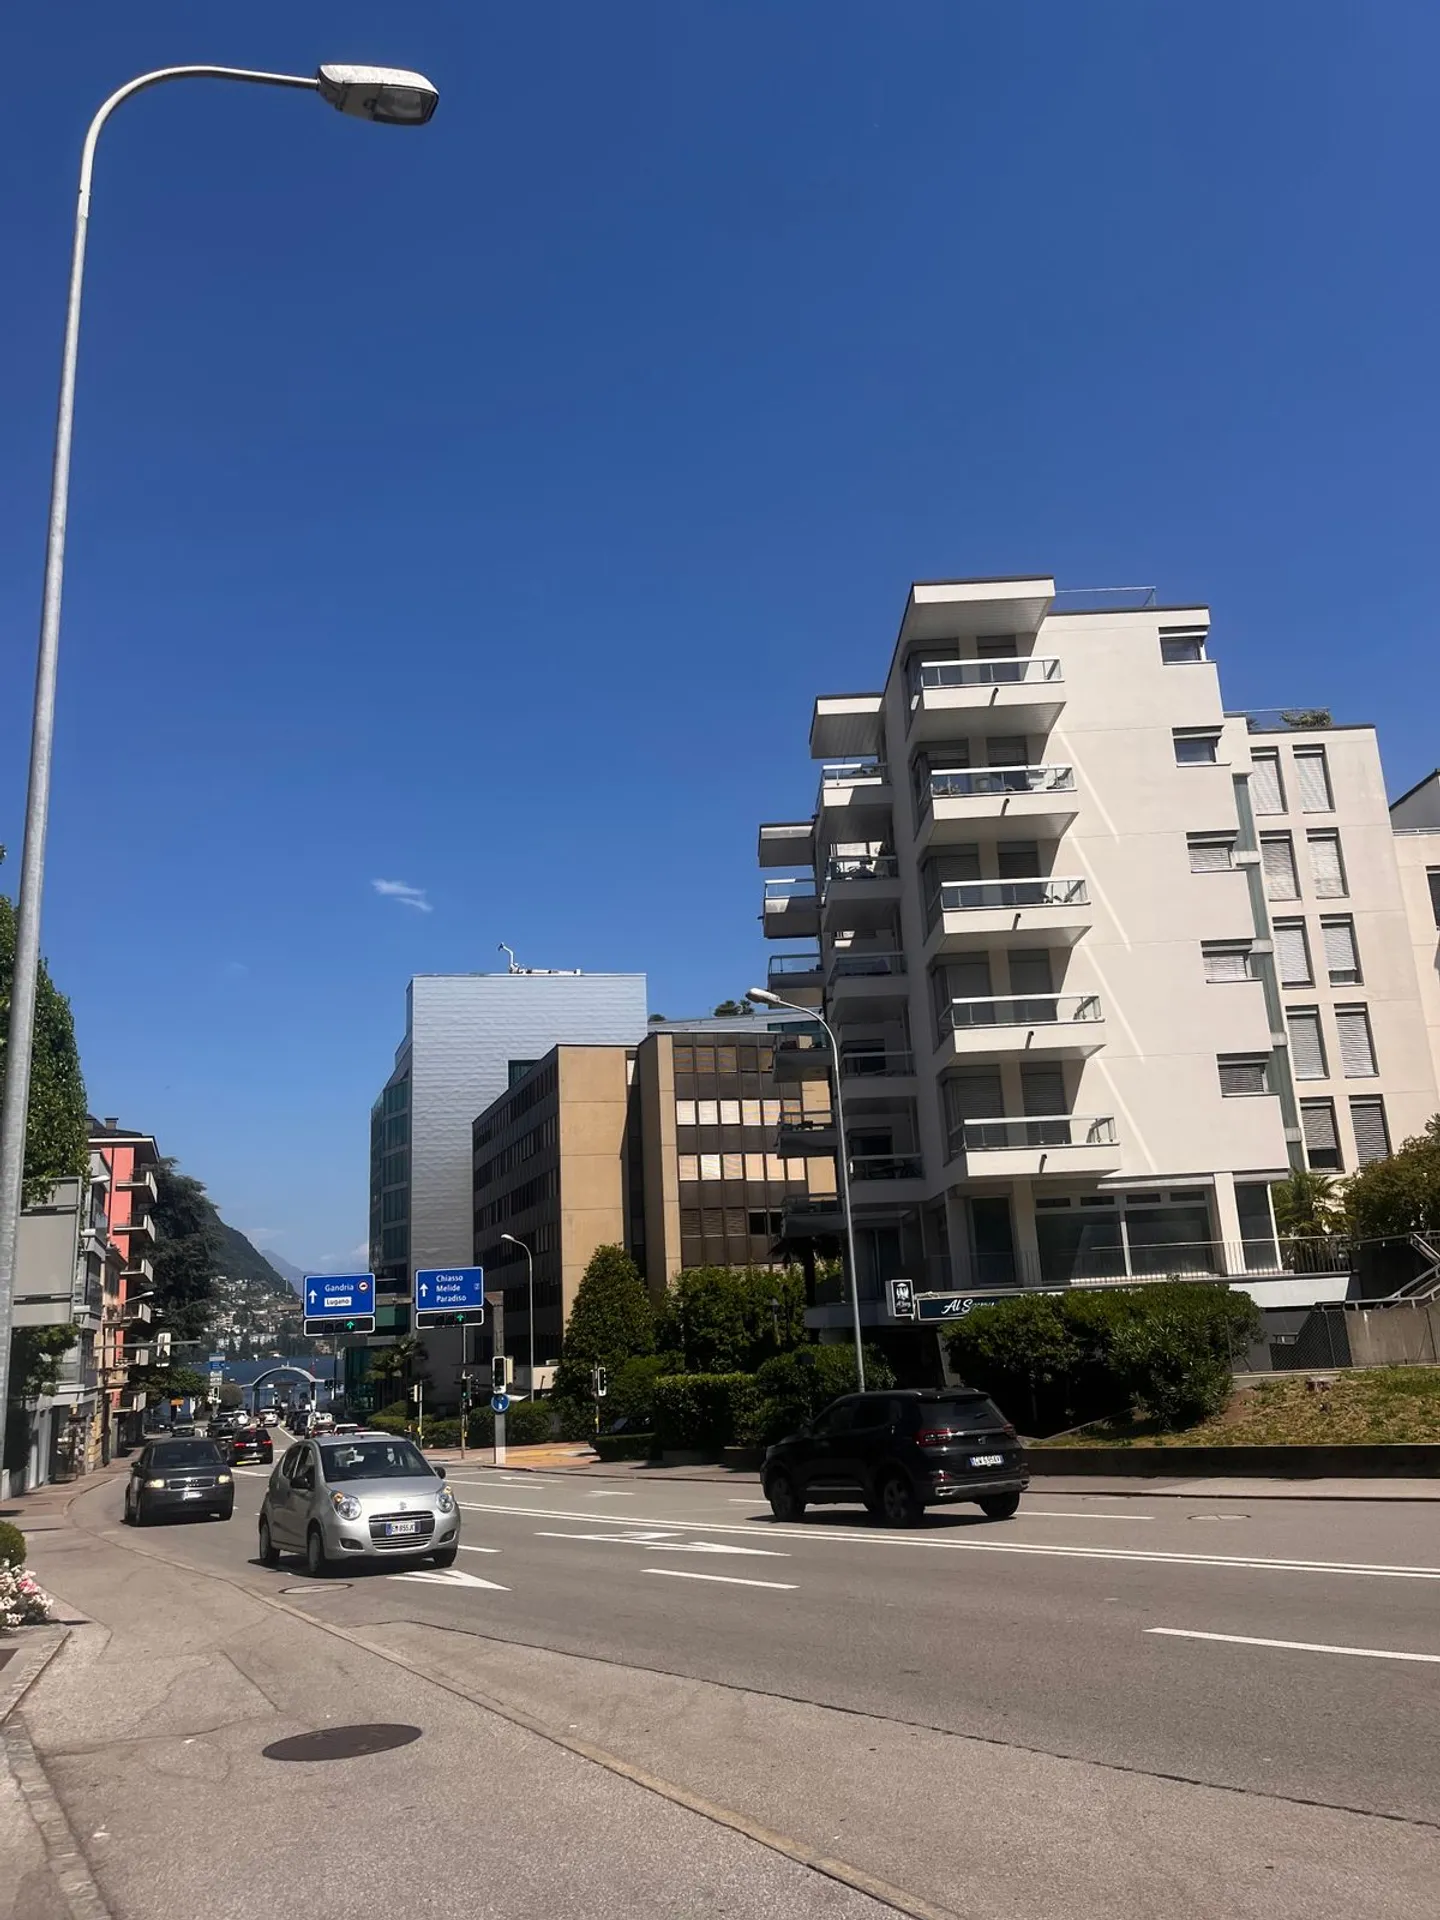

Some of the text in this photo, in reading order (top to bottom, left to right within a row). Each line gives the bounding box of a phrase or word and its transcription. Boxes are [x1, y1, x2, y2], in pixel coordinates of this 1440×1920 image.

[324, 1284, 354, 1292] Gandria
[436, 1284, 461, 1292] Melide
[326, 1298, 350, 1306] Lugano
[436, 1295, 467, 1303] Paradiso
[941, 1299, 961, 1314] Al
